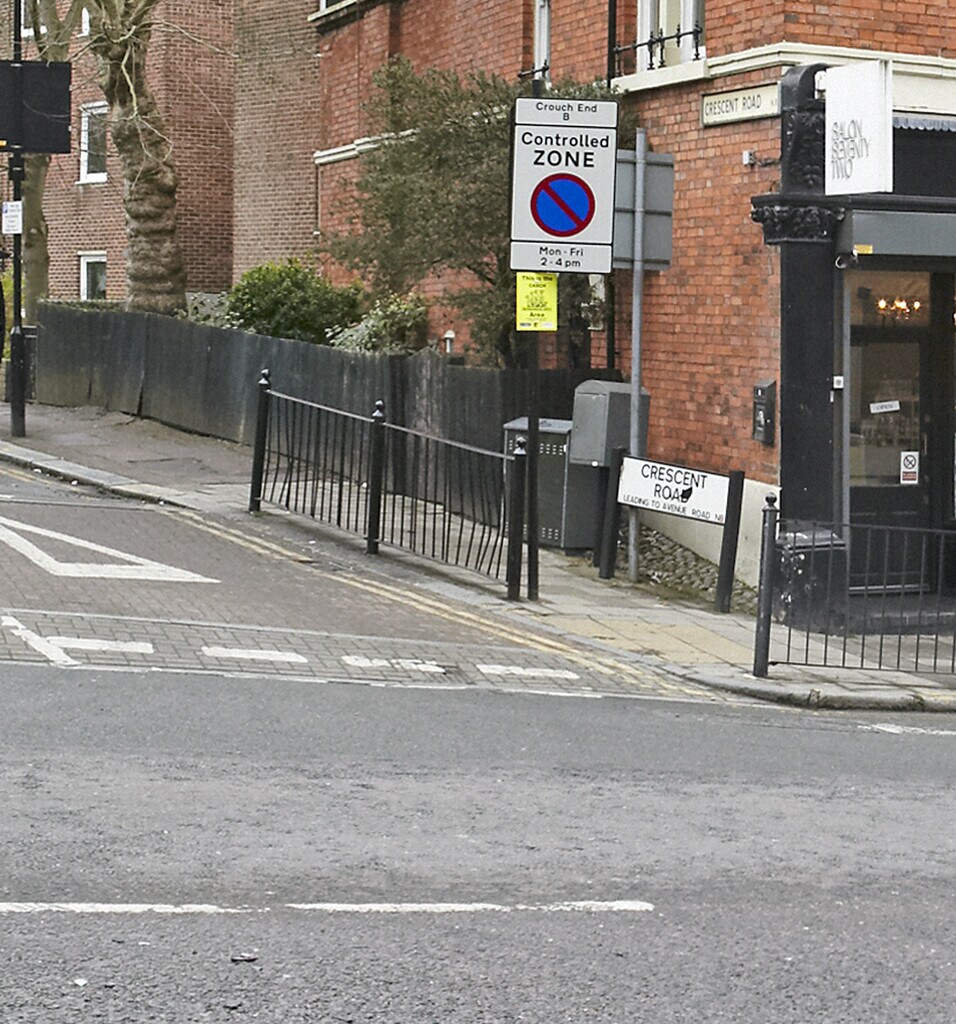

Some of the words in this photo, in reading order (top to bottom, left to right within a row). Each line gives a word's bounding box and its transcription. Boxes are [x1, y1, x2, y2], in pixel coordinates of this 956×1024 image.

[535, 102, 574, 112] Crouch
[577, 103, 598, 113] End
[704, 98, 738, 116] CRESCENT
[742, 94, 762, 110] ROAD
[562, 113, 570, 121] B
[521, 132, 610, 148] Controlled
[533, 150, 595, 168] ZONE
[539, 246, 561, 256] Mon
[570, 248, 584, 257] Fri
[541, 258, 548, 266] 2
[555, 258, 563, 267] 4
[565, 261, 581, 269] pm
[641, 464, 708, 489] CRESCENT
[623, 494, 649, 507] LEADING
[651, 499, 661, 509] TO
[662, 502, 687, 515] AVENUE
[691, 508, 711, 519] ROAD
